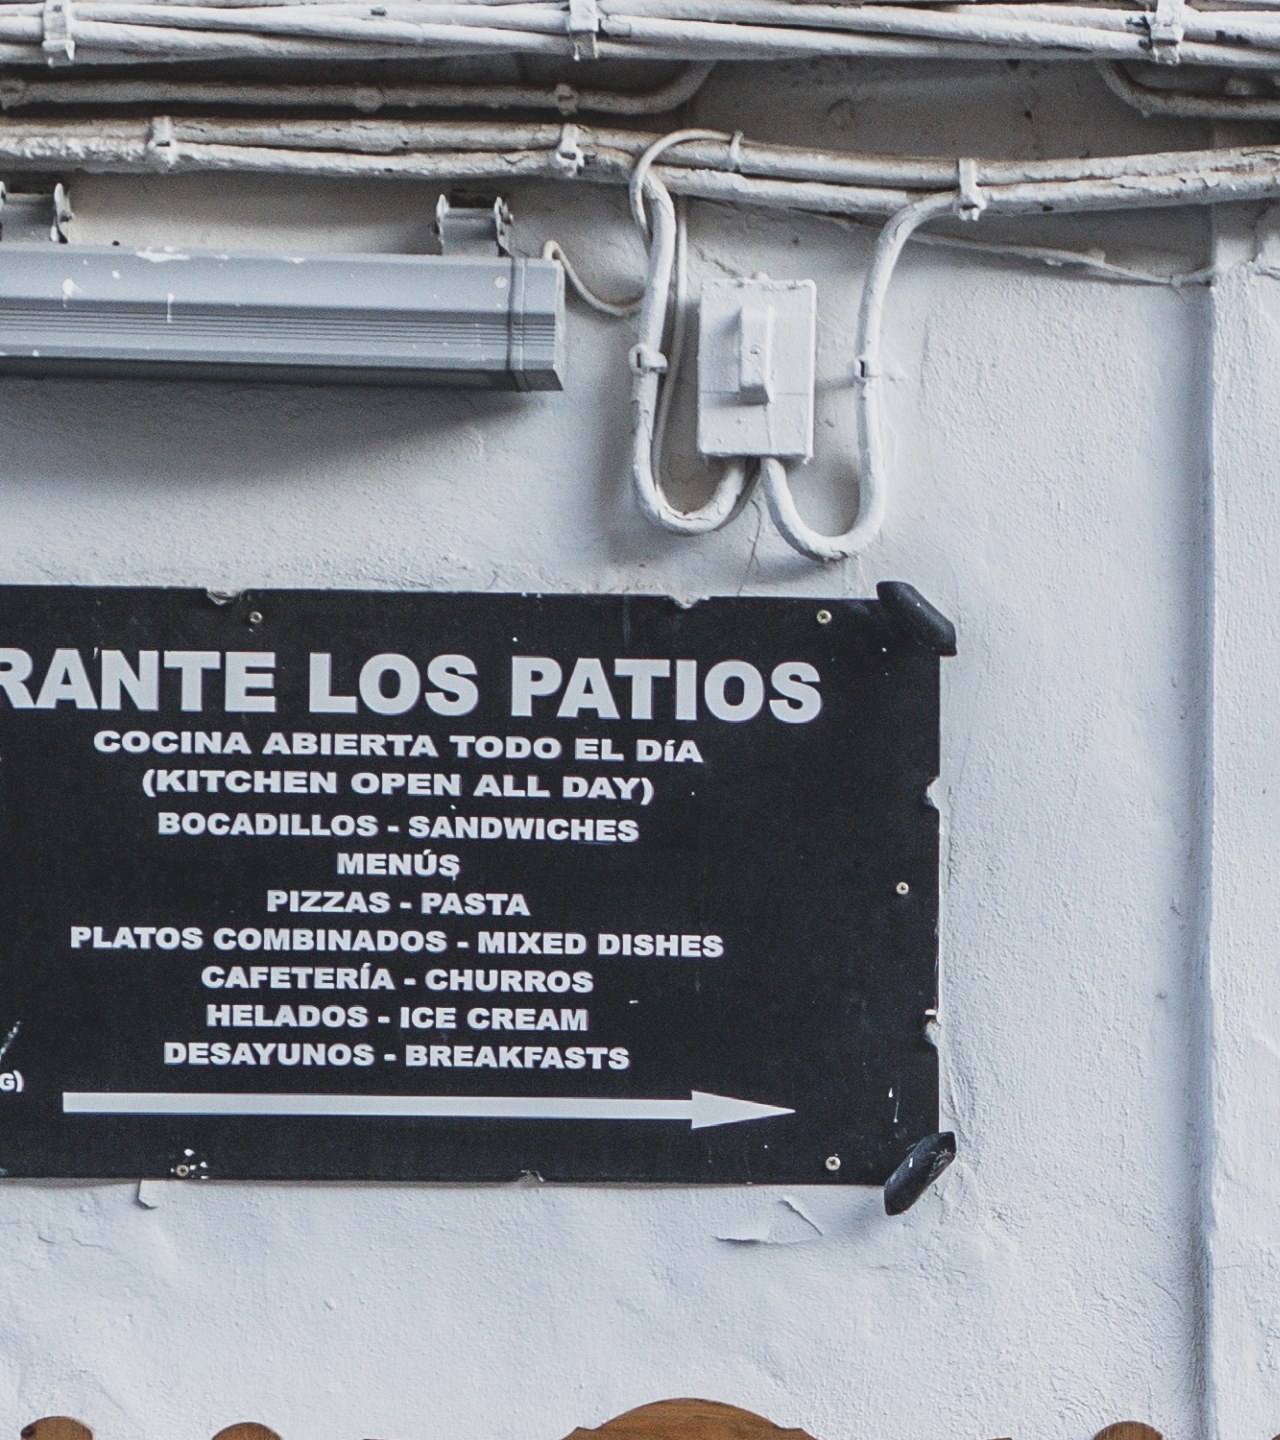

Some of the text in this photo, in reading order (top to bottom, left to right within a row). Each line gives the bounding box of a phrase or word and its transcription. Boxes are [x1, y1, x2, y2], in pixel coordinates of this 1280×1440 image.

[308, 652, 479, 717] LOS
[510, 655, 822, 724] PATIOS
[93, 730, 252, 755] COCINA
[262, 732, 439, 758] ABIERTA
[449, 734, 562, 760] TODO
[574, 737, 625, 762] EL
[142, 768, 654, 806] (KITCHEN OPEN ALL DAY)
[158, 811, 379, 837] BOCADILLOS
[408, 815, 640, 843] SANDWICHES
[337, 848, 461, 878] MENÚS
[266, 889, 391, 914] PIZZAS
[421, 892, 531, 917] PASTA
[70, 925, 204, 951] PLATOS
[213, 927, 448, 953] COMBINADOS
[477, 931, 587, 955] MIXED
[597, 933, 724, 958] DISHES
[201, 962, 396, 990] CAFETERÍA
[425, 968, 594, 994] CHURROS
[206, 1003, 369, 1028] HELADOS
[399, 1006, 457, 1029] ICE
[466, 1007, 588, 1032] CREAM
[164, 1041, 375, 1067] DESAYUNOS
[405, 1044, 630, 1070] BREAKFASTS
